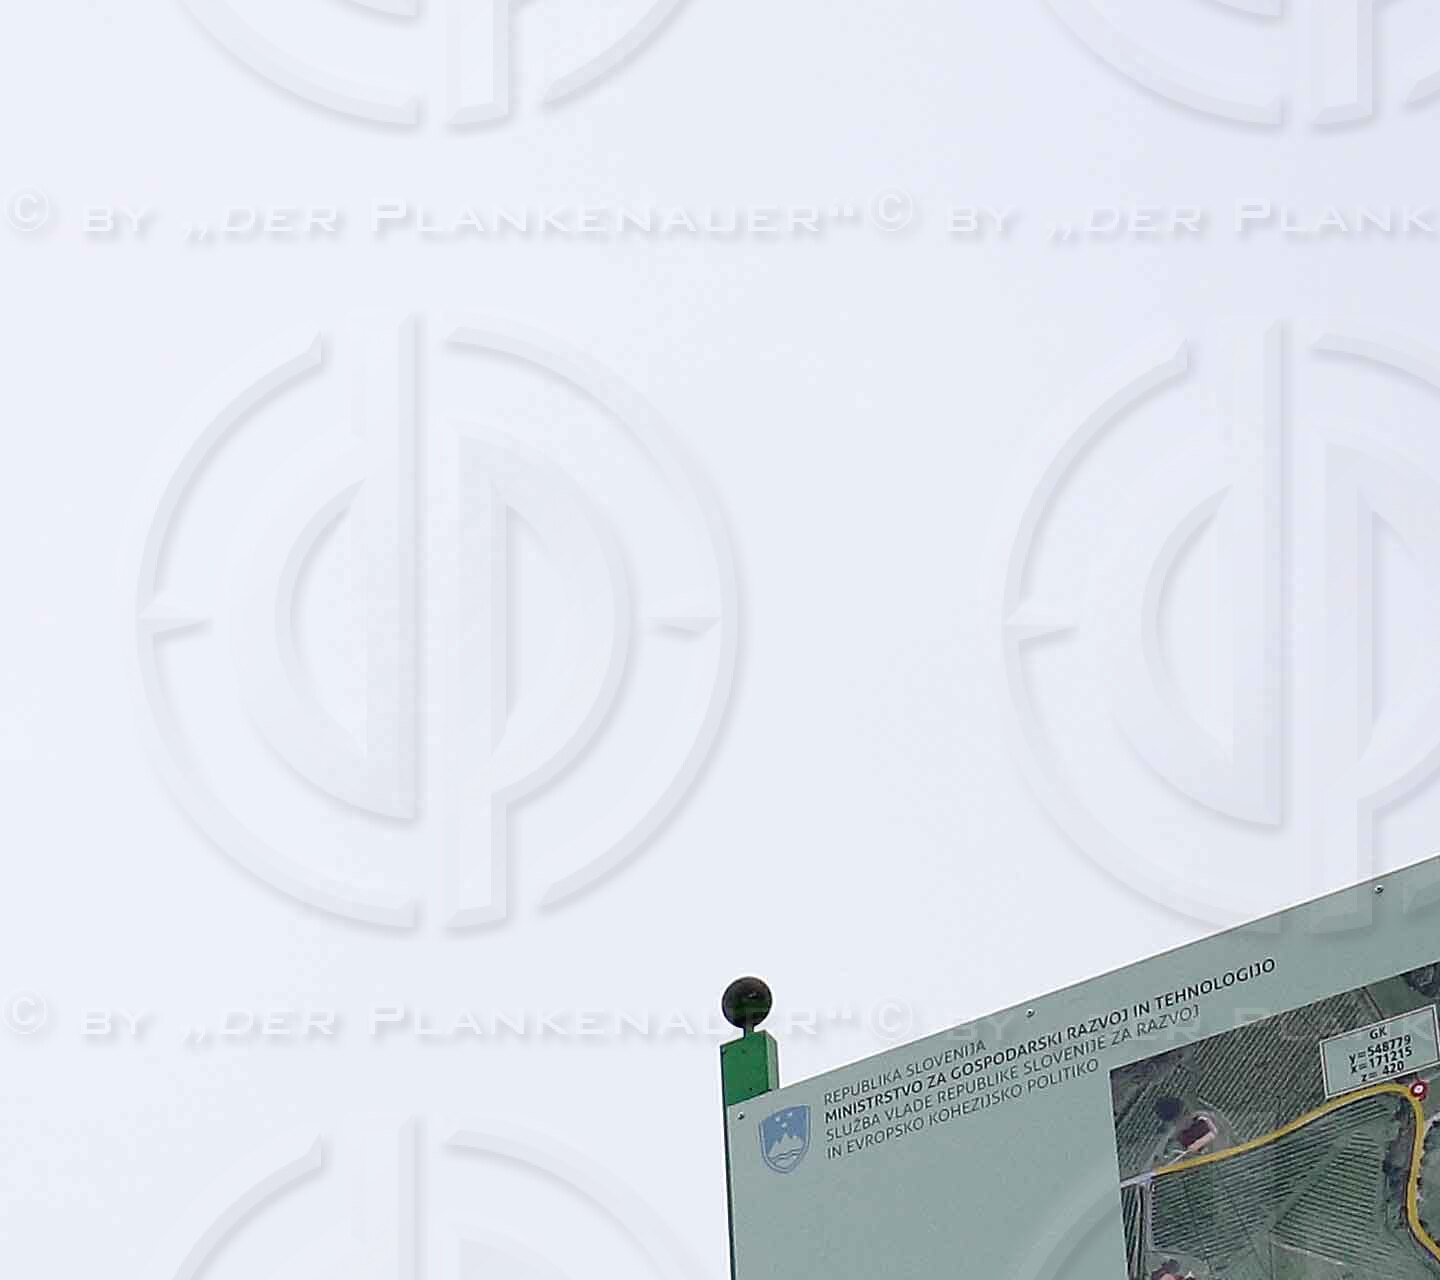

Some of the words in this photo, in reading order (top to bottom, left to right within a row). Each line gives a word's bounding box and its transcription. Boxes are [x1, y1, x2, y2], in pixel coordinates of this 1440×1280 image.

[824, 1068, 902, 1105] REPUBLIKA
[906, 1040, 986, 1077] SLOVENIJA
[826, 1080, 922, 1121] MINISTRSTVO
[927, 1072, 946, 1086] ZA
[951, 1032, 1062, 1078] GOSPODARSKI
[1067, 1009, 1128, 1040] RAZVOJ
[1134, 1001, 1149, 1017] IN
[1154, 959, 1275, 1009] TEHNOLOGIJO
[826, 1114, 880, 1142] SLUŽBA
[884, 1095, 933, 1121] VLADE
[938, 1065, 1018, 1104] REPUBLIKE
[1024, 1035, 1106, 1075] SLOVENIJE
[1111, 1028, 1132, 1045] ZA
[1137, 1004, 1199, 1036] RAZVOJ
[828, 1144, 841, 1160] IN
[847, 1117, 924, 1153] EVROPSKO
[929, 1084, 1022, 1126] KOHEZIJSKO
[1028, 1059, 1098, 1093] POLITIKO
